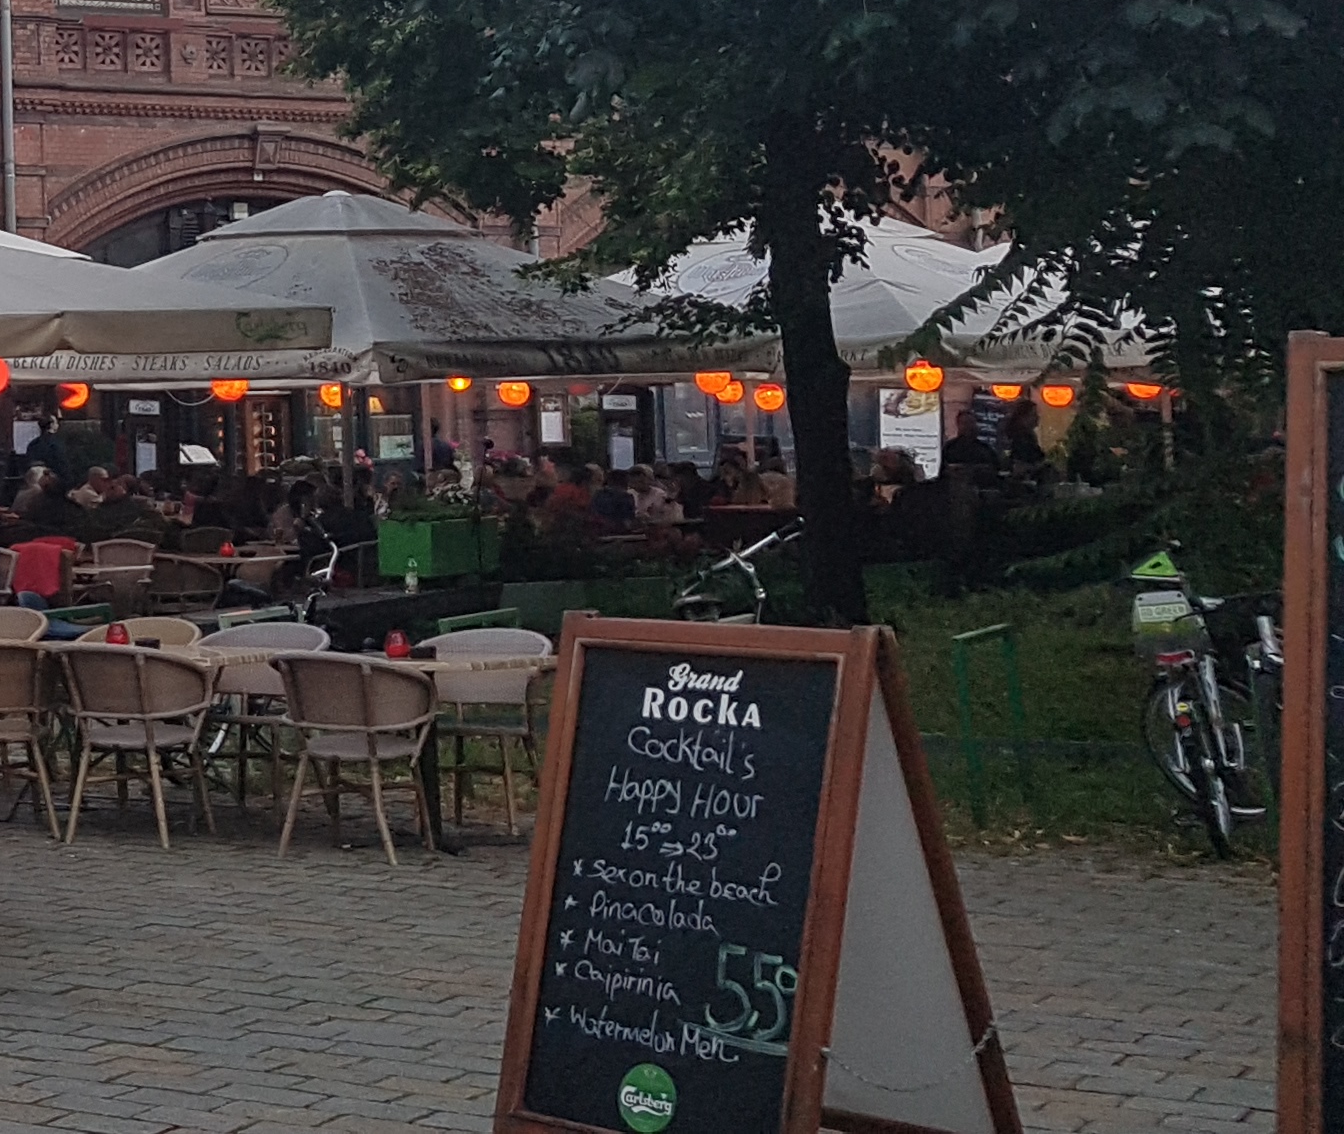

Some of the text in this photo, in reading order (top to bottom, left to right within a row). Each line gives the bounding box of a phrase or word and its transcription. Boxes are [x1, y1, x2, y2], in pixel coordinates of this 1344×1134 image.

[13, 354, 264, 371] BERLIN DISHES STEAKS SALADS
[668, 663, 744, 692] Grand
[604, 765, 682, 814] Happy
[662, 860, 705, 894] the
[620, 1085, 672, 1116] Carlsberg
